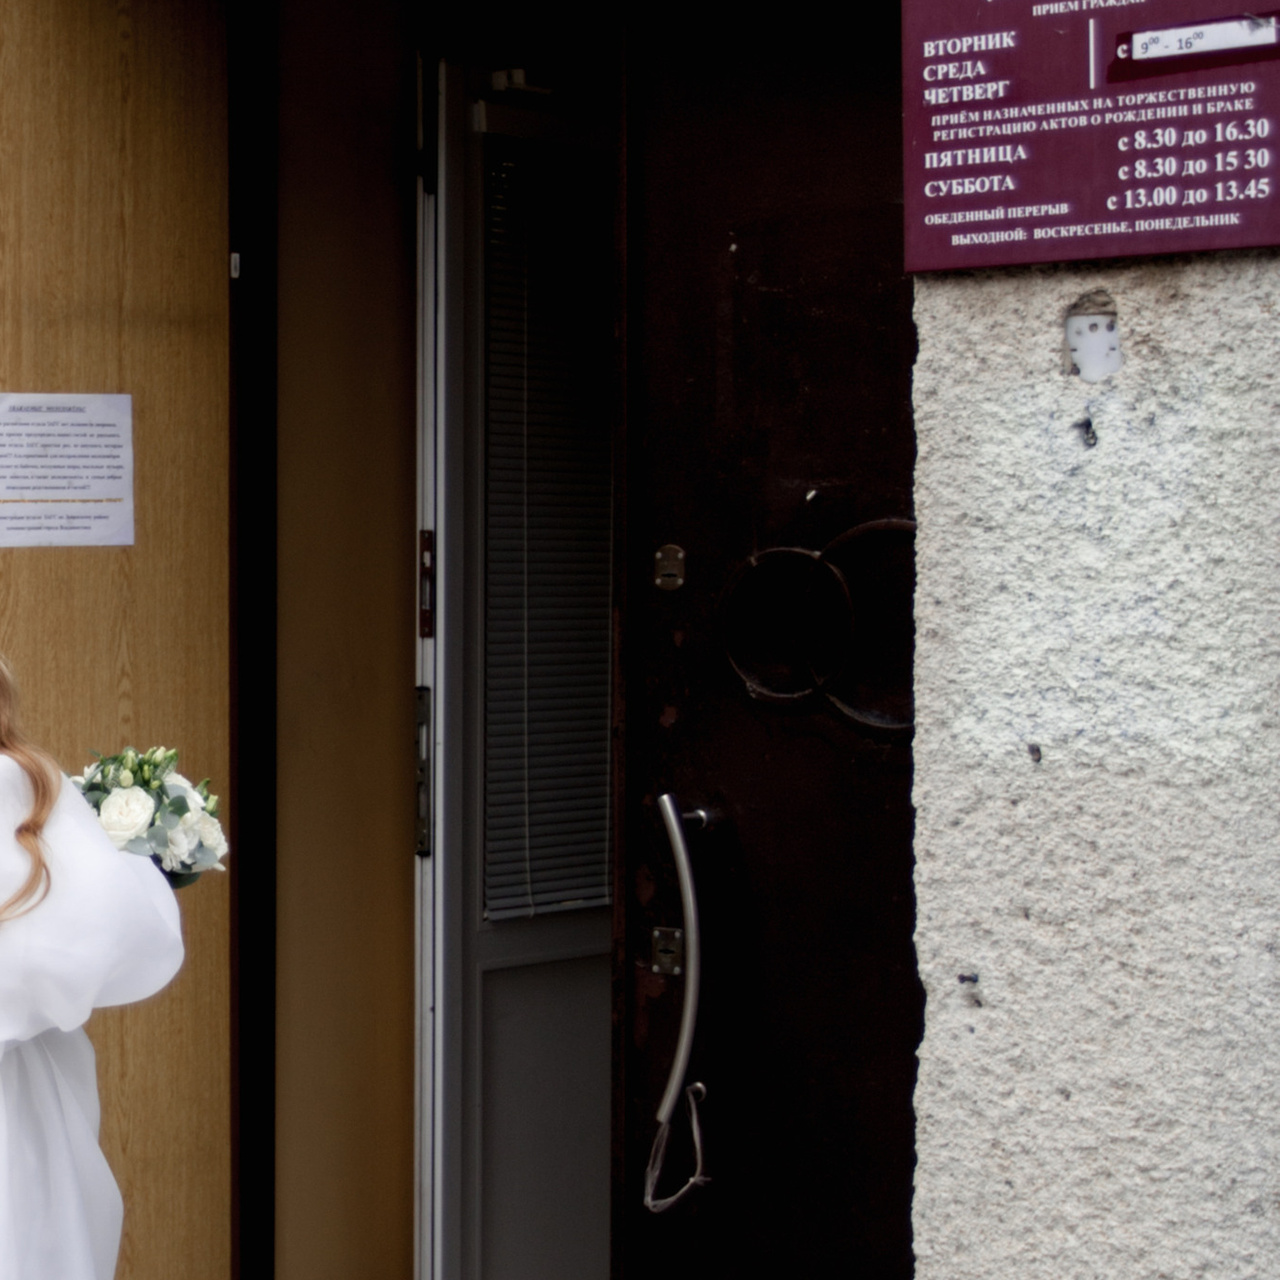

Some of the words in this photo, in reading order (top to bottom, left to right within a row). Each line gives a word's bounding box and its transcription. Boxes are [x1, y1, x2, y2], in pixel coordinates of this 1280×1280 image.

[1032, 0, 1079, 16] ПРИЕМ
[923, 31, 1016, 58] ВТОРНИК
[1117, 44, 1128, 59] с
[923, 60, 986, 81] СРЕДА
[923, 80, 1009, 105] ЧЕТВЕРГ
[931, 110, 980, 126] ПРИЁМ
[983, 100, 1089, 121] НАЗНАЧЕННЫХ
[1093, 98, 1113, 109] НА
[1116, 81, 1255, 106] ТОРЖЕСТВЕННУЮ
[933, 121, 1036, 142] РЕГИСТРАЦИЮ
[1040, 114, 1087, 130] АКТОВ
[1091, 114, 1101, 125] О
[1105, 105, 1188, 124] РОЖДЕНИИ
[1192, 104, 1202, 115] И
[1207, 98, 1254, 114] БРАКЕ
[924, 145, 1027, 169] ПЯТНИЦА
[1118, 136, 1128, 151] с
[1135, 127, 1176, 150] 8.30
[1181, 130, 1207, 147] до
[1215, 118, 1269, 142] 16.30
[924, 175, 1015, 197] СУББОТА
[1118, 166, 1129, 180] с
[1135, 157, 1176, 179] 8.30
[1182, 159, 1207, 177] до
[924, 206, 1004, 225] ОБЕДЕННЫЙ
[1007, 203, 1069, 219] ПЕРЕРЫВ
[1107, 196, 1117, 210] с
[1125, 186, 1177, 209] 13.00
[1182, 189, 1207, 206] до
[1215, 178, 1270, 202] 13.45
[951, 228, 1028, 246] ВЫХОДНОЙ:
[1033, 221, 1132, 240] ВОСКРЕСЕНЬЕ,
[1135, 213, 1240, 232] ПОНЕДЕЛЬНИК
